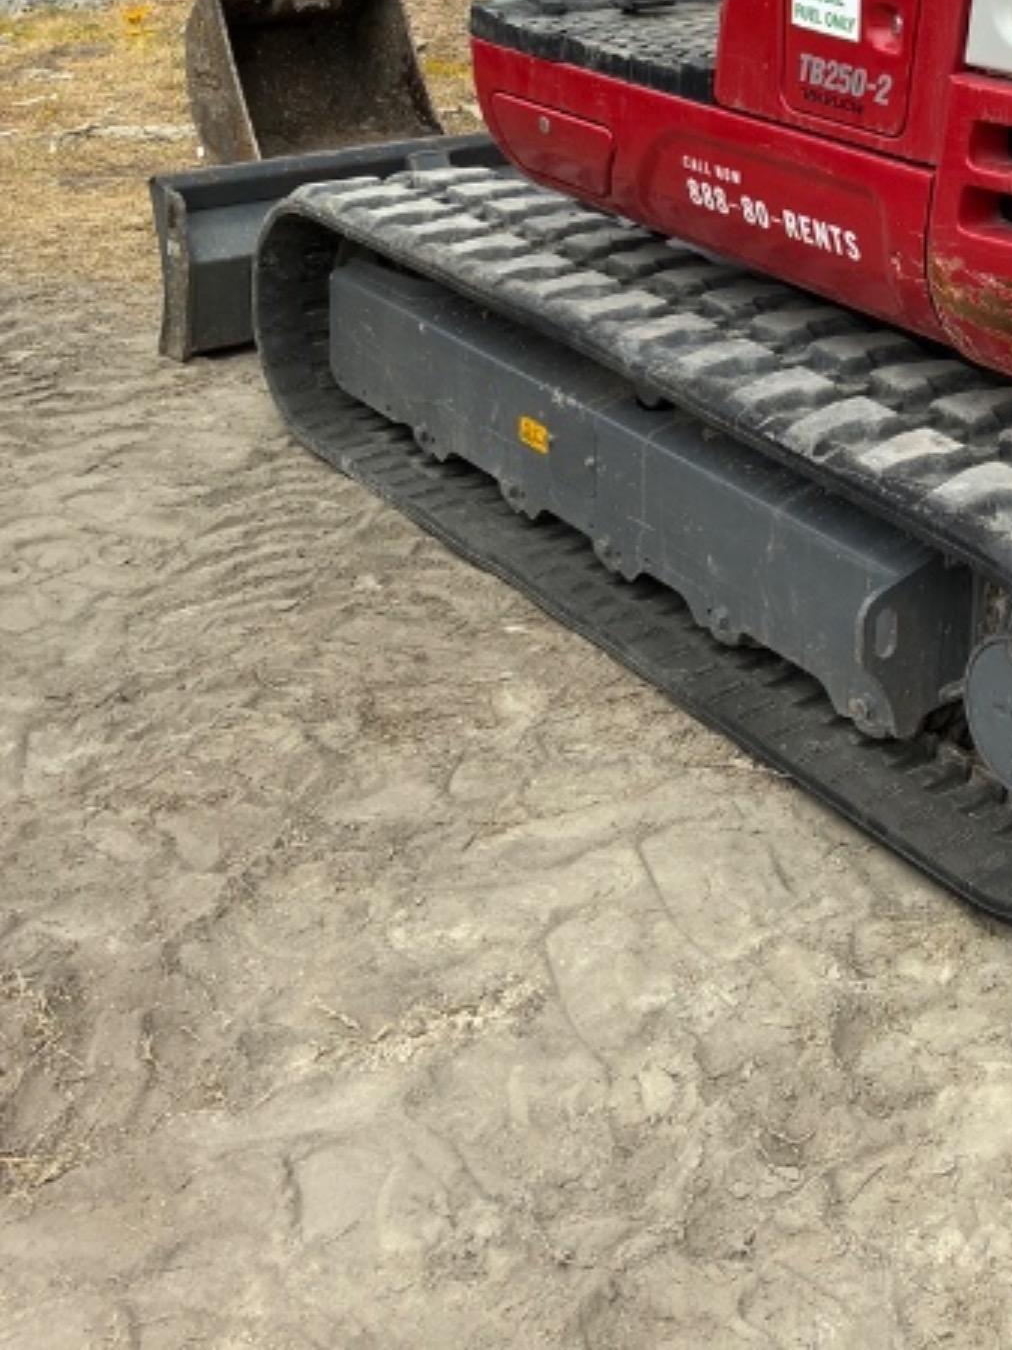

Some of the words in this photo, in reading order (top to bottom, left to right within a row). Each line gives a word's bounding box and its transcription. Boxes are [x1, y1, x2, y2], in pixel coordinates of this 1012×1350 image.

[794, 2, 822, 25] FUEL
[825, 11, 857, 34] ONLY
[799, 52, 893, 107] TB250-2
[682, 154, 711, 176] CALL
[686, 177, 862, 262] 888-80-RENTS
